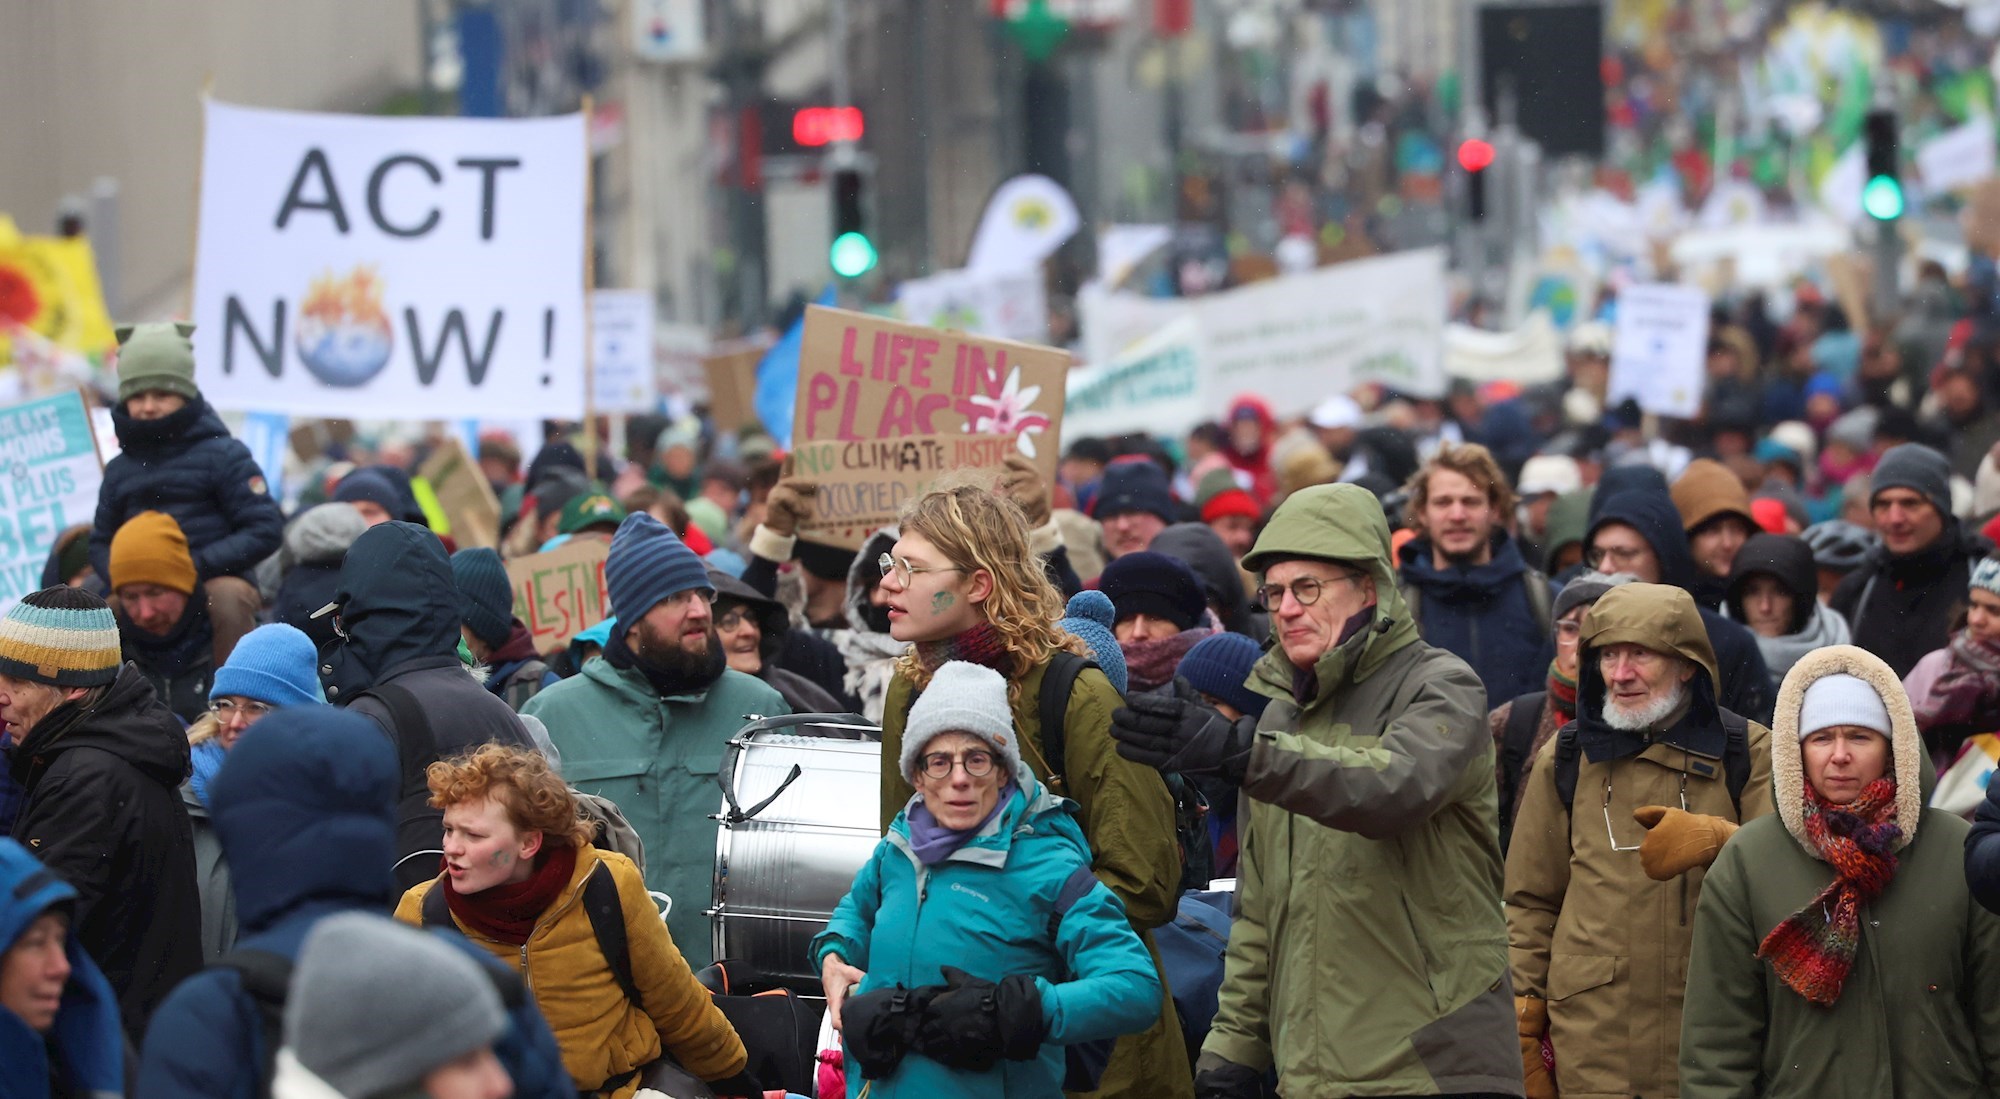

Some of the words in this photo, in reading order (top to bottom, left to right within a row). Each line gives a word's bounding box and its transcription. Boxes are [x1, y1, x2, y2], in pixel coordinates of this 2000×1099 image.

[274, 148, 522, 241] ACT
[840, 326, 940, 389] LIFE
[951, 343, 1008, 401] IN
[12, 466, 76, 505] PLUS
[796, 444, 835, 476] NO
[842, 440, 944, 472] CLIMATE
[816, 480, 908, 519] OCCUPIED
[511, 560, 608, 639] ALESTINE
